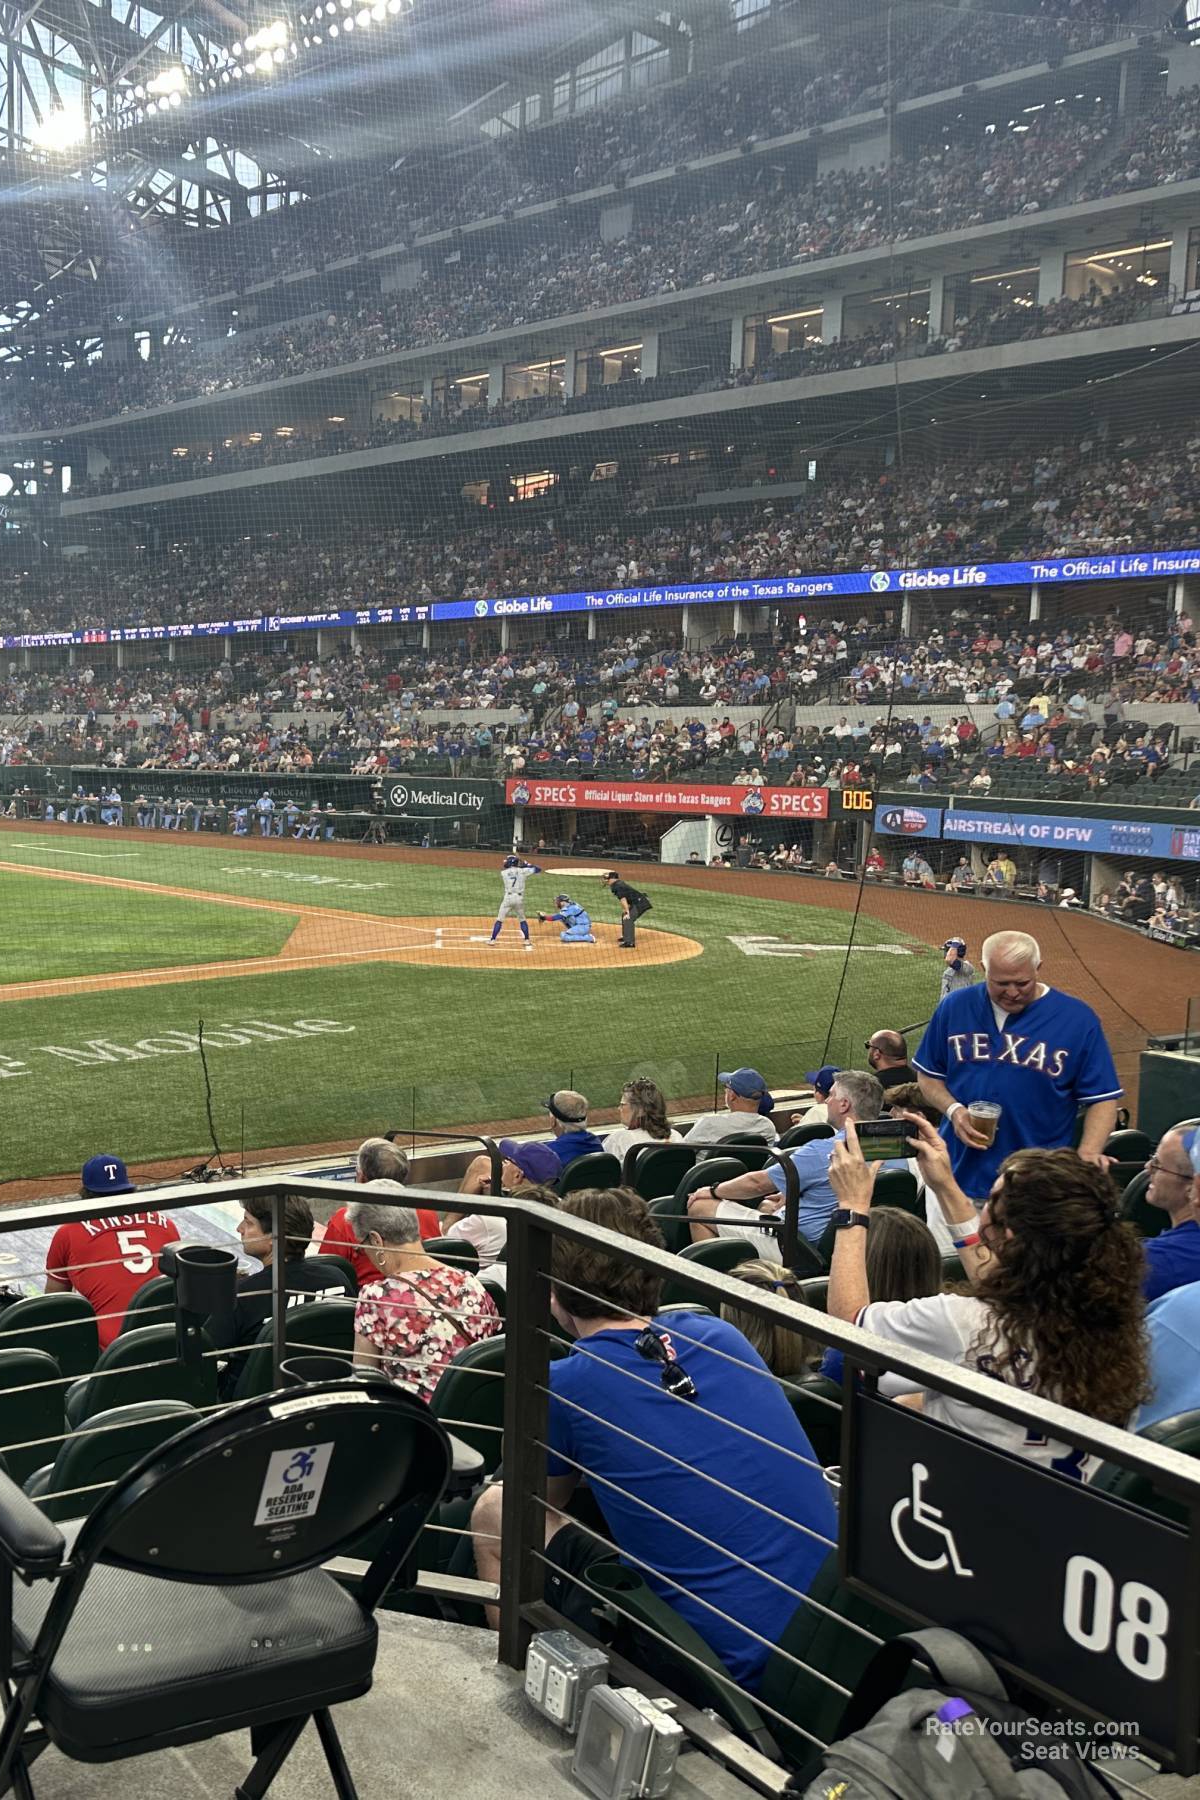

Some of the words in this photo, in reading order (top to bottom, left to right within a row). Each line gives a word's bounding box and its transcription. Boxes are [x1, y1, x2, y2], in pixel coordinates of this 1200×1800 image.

[899, 572, 950, 588] Globe
[953, 566, 987, 584] Life
[1031, 565, 1058, 579] The
[1063, 560, 1115, 577] Official
[1120, 558, 1149, 573] Life
[585, 595, 603, 606] The
[606, 592, 640, 605] Official
[644, 590, 661, 602] Life
[665, 588, 715, 601] Insurance
[718, 586, 729, 597] of
[731, 585, 748, 596] the
[752, 584, 783, 596] Texas
[787, 580, 833, 596] Rangers
[494, 600, 529, 615] Globe
[530, 596, 552, 611] Life
[280, 616, 306, 624] BOBBY
[307, 614, 327, 622] WITT
[411, 790, 457, 806] Medical
[459, 791, 485, 810] City
[535, 784, 576, 802] SPEC'S
[584, 789, 610, 800] Official
[611, 790, 633, 803] Liquor
[634, 791, 653, 803] Store
[655, 792, 663, 803] of
[664, 792, 677, 804] the
[678, 793, 699, 805] Texas
[701, 793, 731, 807] Rangers
[770, 791, 824, 812] SPEC'S
[842, 790, 873, 810] 006
[943, 818, 1024, 837] AIRSTREAM
[1029, 824, 1050, 838] OF
[1053, 826, 1093, 842] DFW
[30, 1019, 355, 1067] Mobile
[947, 1032, 1070, 1077] TEXAS
[104, 1164, 117, 1181] T
[82, 1211, 168, 1237] KINSLER
[116, 1231, 153, 1274] 5
[265, 1490, 316, 1508] RESERVED
[283, 1483, 303, 1495] ADA
[267, 1501, 309, 1517] SEATING
[1063, 1554, 1170, 1682] 08
